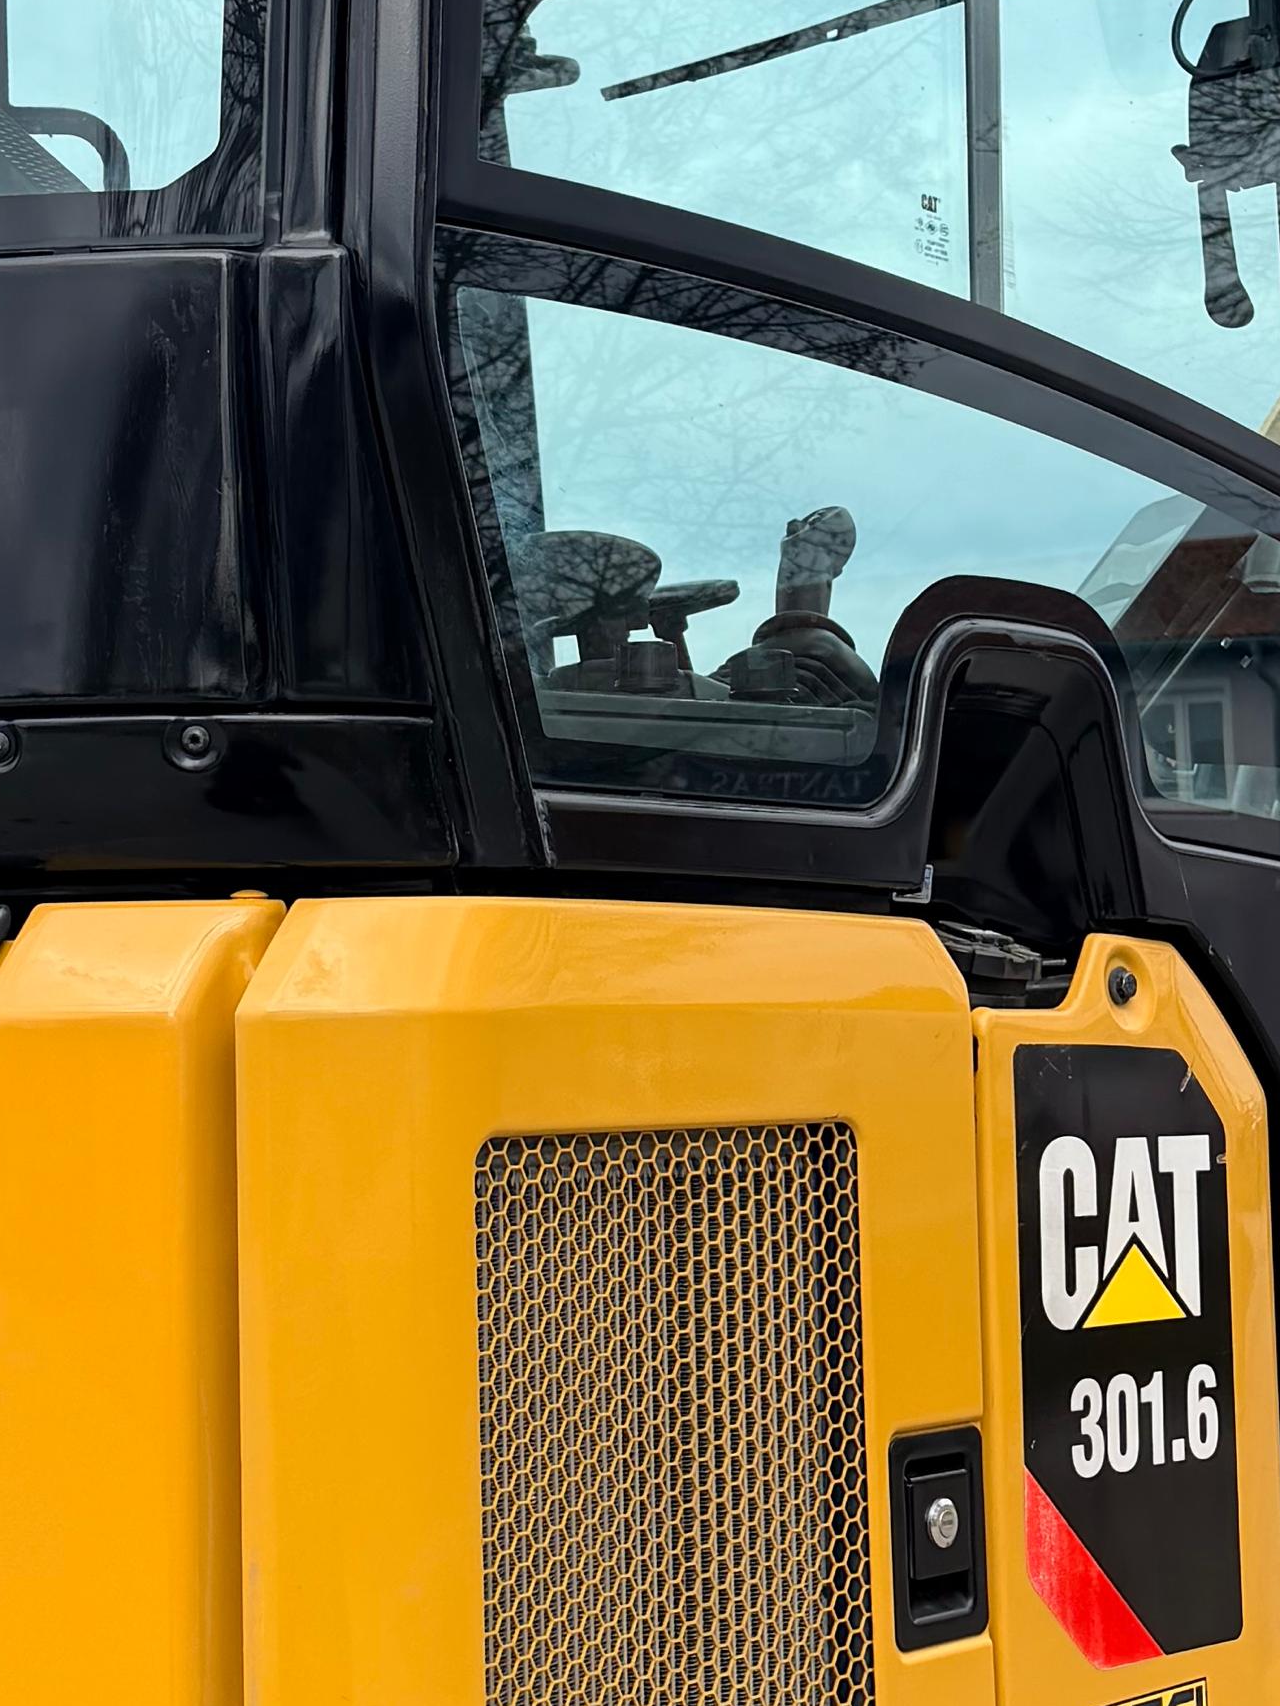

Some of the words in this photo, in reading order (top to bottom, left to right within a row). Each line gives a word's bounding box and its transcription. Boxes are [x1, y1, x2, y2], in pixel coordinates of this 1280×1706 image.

[920, 193, 938, 213] CAT
[1038, 1134, 1212, 1332] CAT
[1069, 1362, 1220, 1481] 301.6
